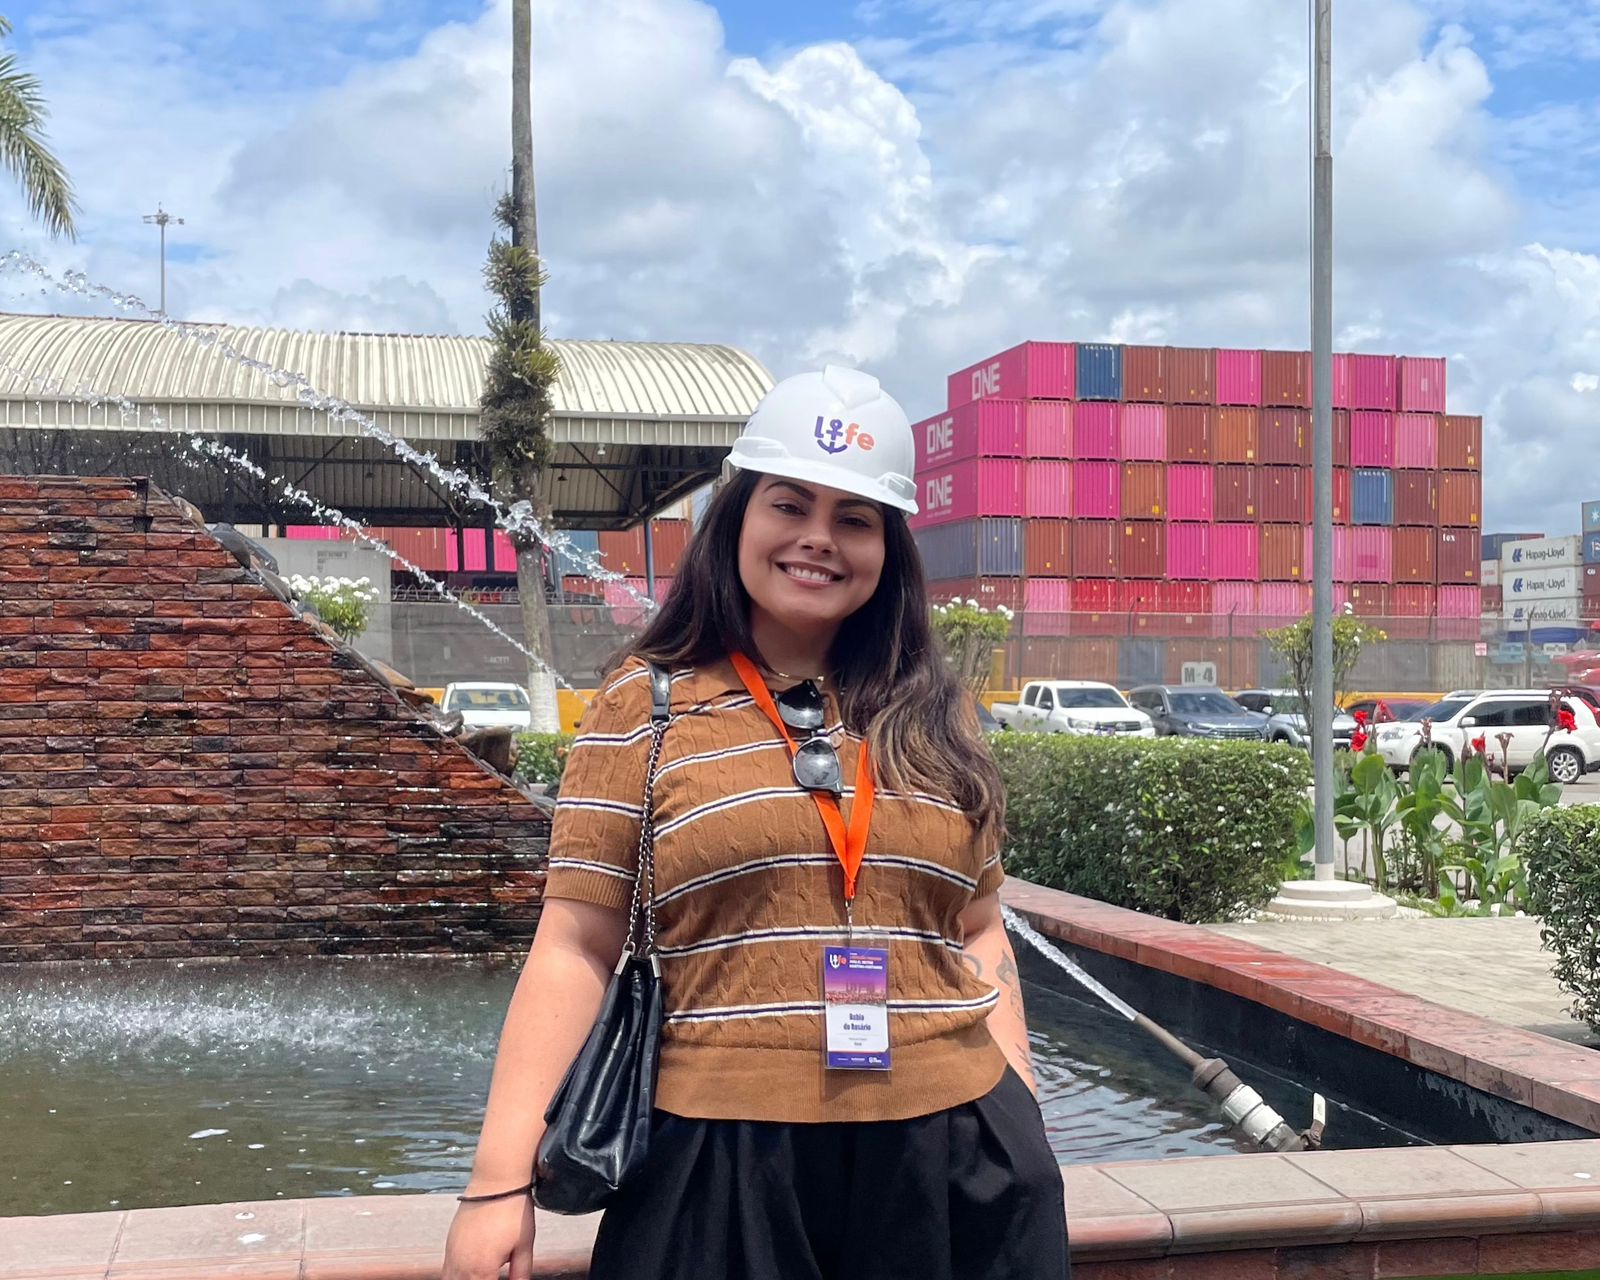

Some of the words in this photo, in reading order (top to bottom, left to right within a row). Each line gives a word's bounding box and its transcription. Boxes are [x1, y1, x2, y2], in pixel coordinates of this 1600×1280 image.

[971, 361, 1000, 401] ONE
[926, 417, 954, 455] ONE
[926, 474, 953, 511] ONE
[1525, 547, 1565, 561] Hapag-Lloyd
